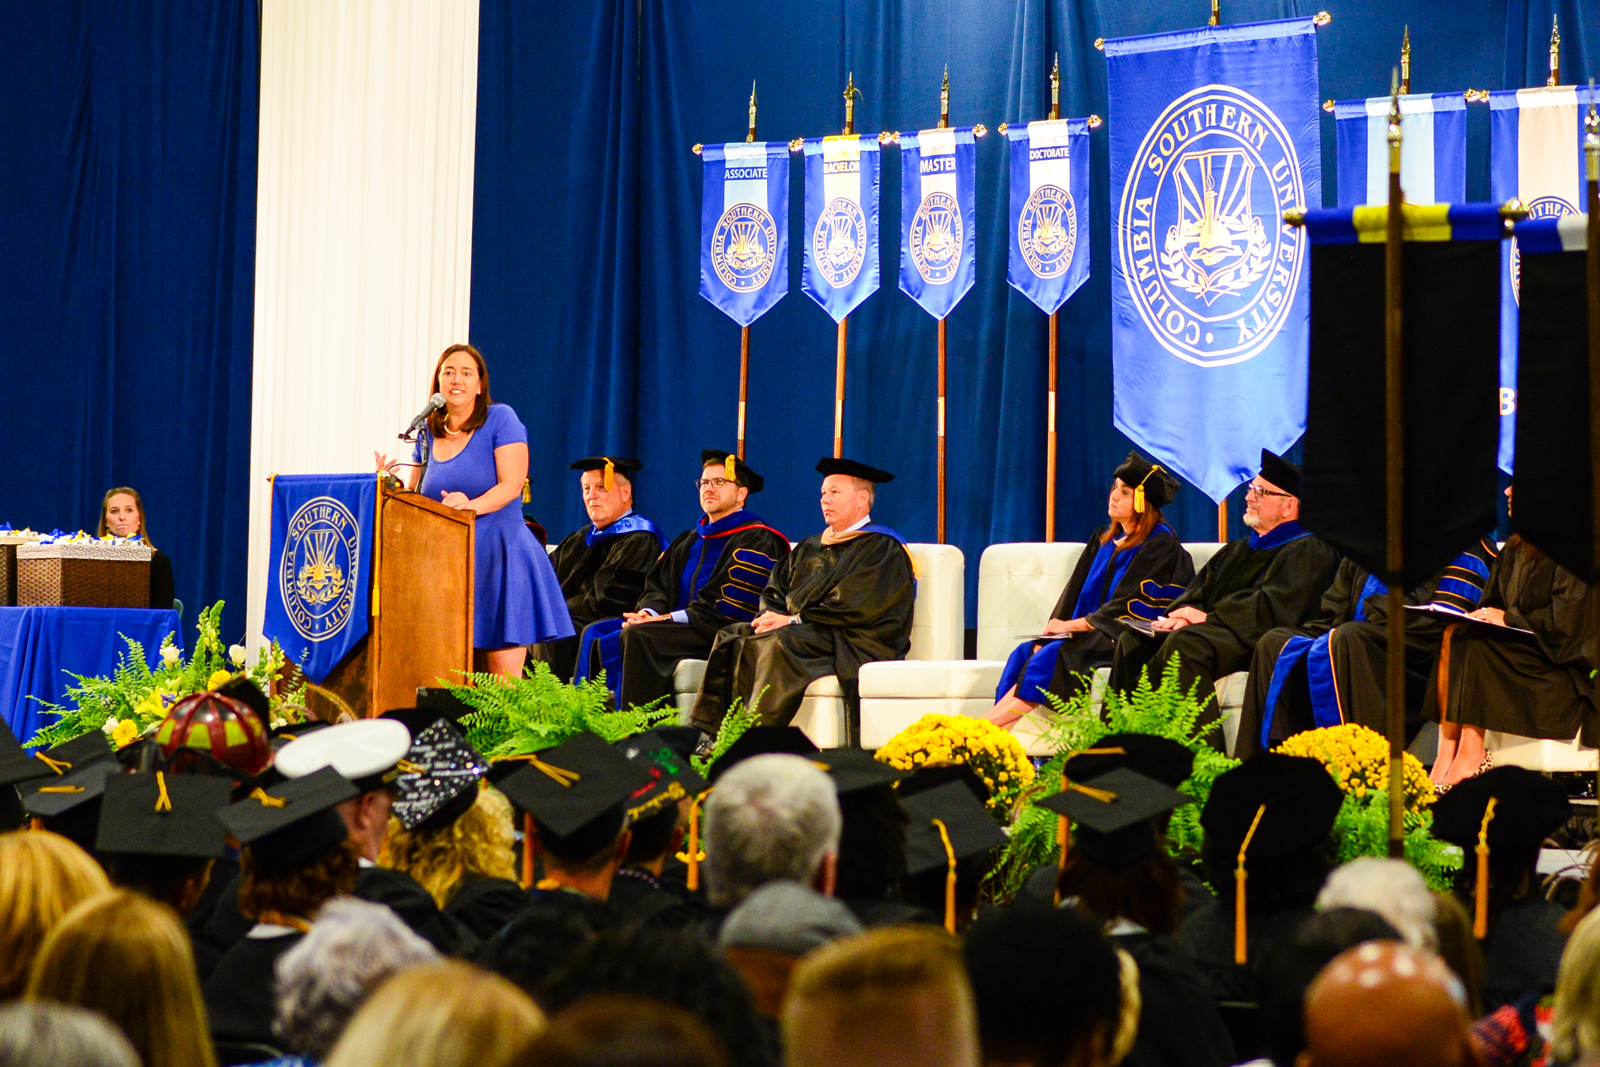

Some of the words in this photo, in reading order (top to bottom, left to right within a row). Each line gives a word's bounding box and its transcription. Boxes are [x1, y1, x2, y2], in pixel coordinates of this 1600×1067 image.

[1029, 147, 1070, 160] DOCTORATE
[1148, 103, 1269, 178] SOUTHERN
[724, 168, 768, 179] ASSOCIATE
[823, 161, 860, 174] BACHELOR
[920, 157, 956, 173] MASTER
[722, 207, 766, 230] SOUTHERN
[1028, 188, 1068, 213] SOUTHERN
[716, 235, 737, 286] COLUMBIA
[752, 225, 775, 286] UNIVERSITY
[1130, 195, 1201, 345] COLUMBIA
[1236, 157, 1297, 345] UNVERSITY
[291, 506, 347, 541] SOUTHERN
[285, 551, 312, 629] COLUMBIA
[324, 535, 358, 629] UNIVERSITY
